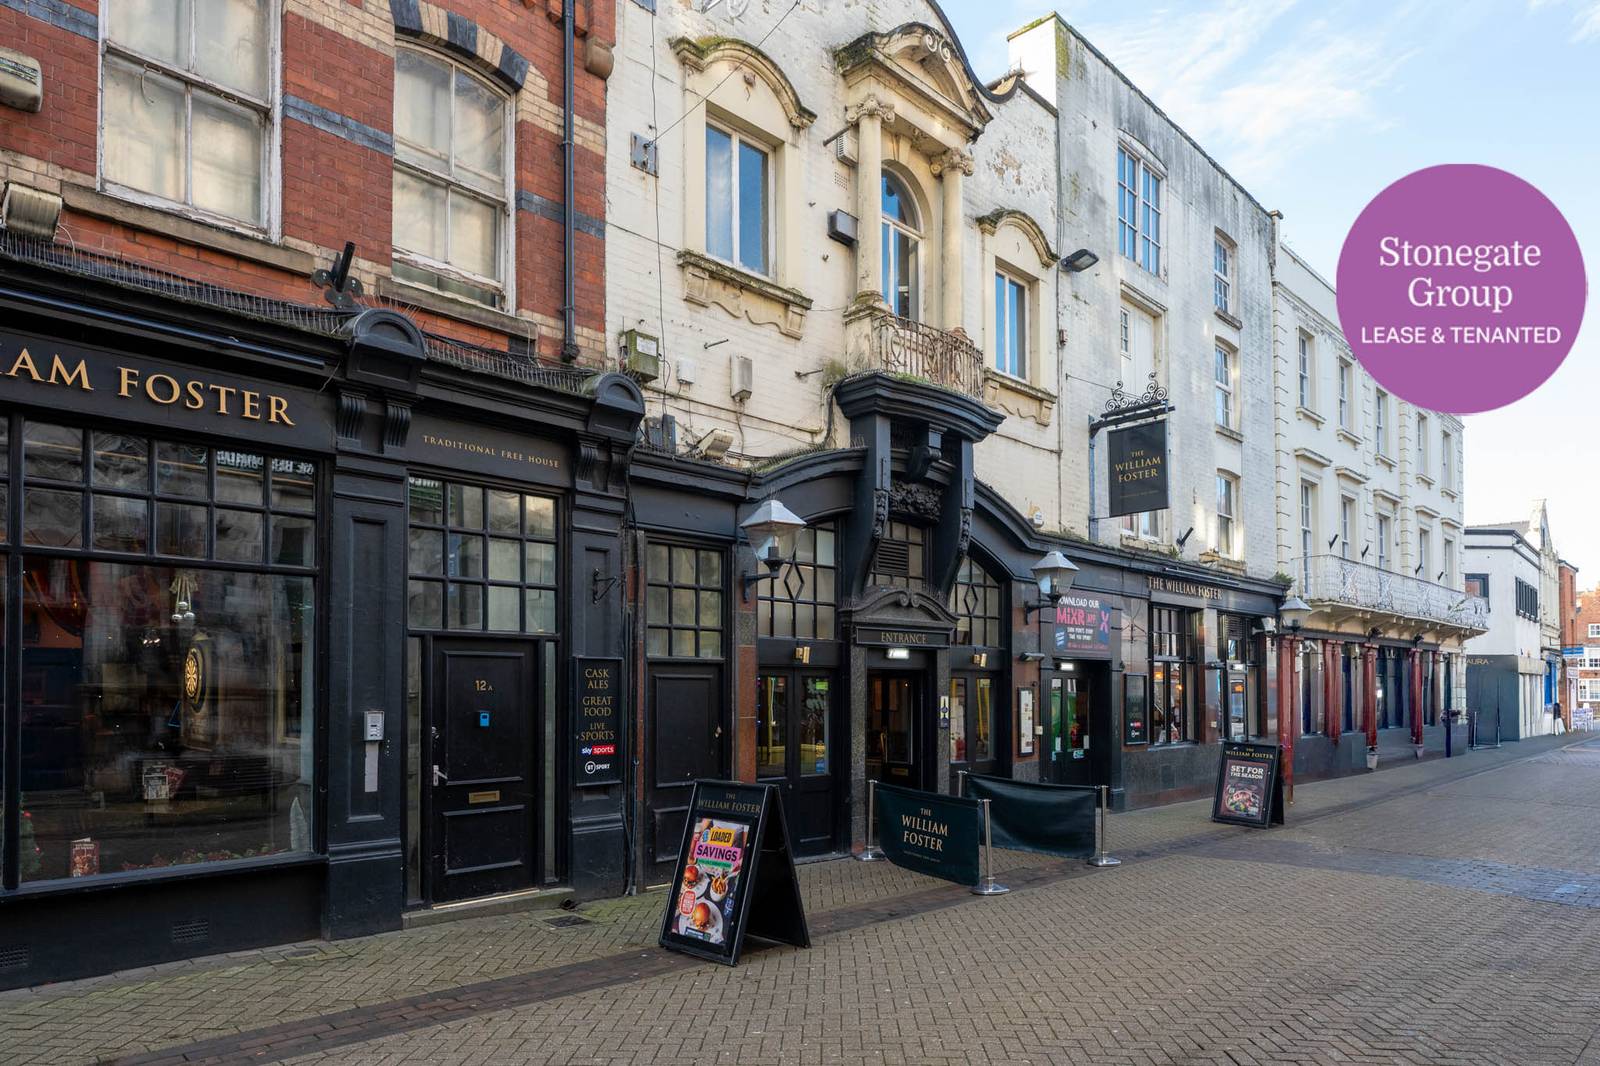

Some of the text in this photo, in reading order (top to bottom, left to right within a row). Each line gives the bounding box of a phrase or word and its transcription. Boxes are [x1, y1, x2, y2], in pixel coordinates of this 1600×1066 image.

[0, 347, 297, 426] AM FOSTER
[423, 435, 560, 469] TRADITIONAL FREE HOUSE
[1131, 450, 1144, 458] THE
[1115, 457, 1161, 472] WILLIAM
[1118, 468, 1158, 483] FOSTER
[1147, 576, 1223, 600] THE WILLIAM FOSTER
[1088, 599, 1100, 608] OUR
[881, 631, 928, 644] ENTRANCE
[585, 668, 609, 679] CASK
[587, 680, 609, 690] ALES
[582, 696, 612, 706] GREAT
[584, 707, 612, 717] FOOD
[590, 722, 606, 731] LIVE
[580, 731, 614, 741] SPORTS
[581, 747, 592, 756] sky
[1231, 765, 1246, 773] SET
[725, 792, 736, 800] THE
[699, 800, 761, 813] WILLIAM FOSTER
[920, 807, 932, 817] THE
[901, 814, 948, 837] WILLIAM
[710, 830, 732, 843] LOADED
[903, 830, 943, 852] FOSTER
[696, 844, 738, 862] SAVINGS
